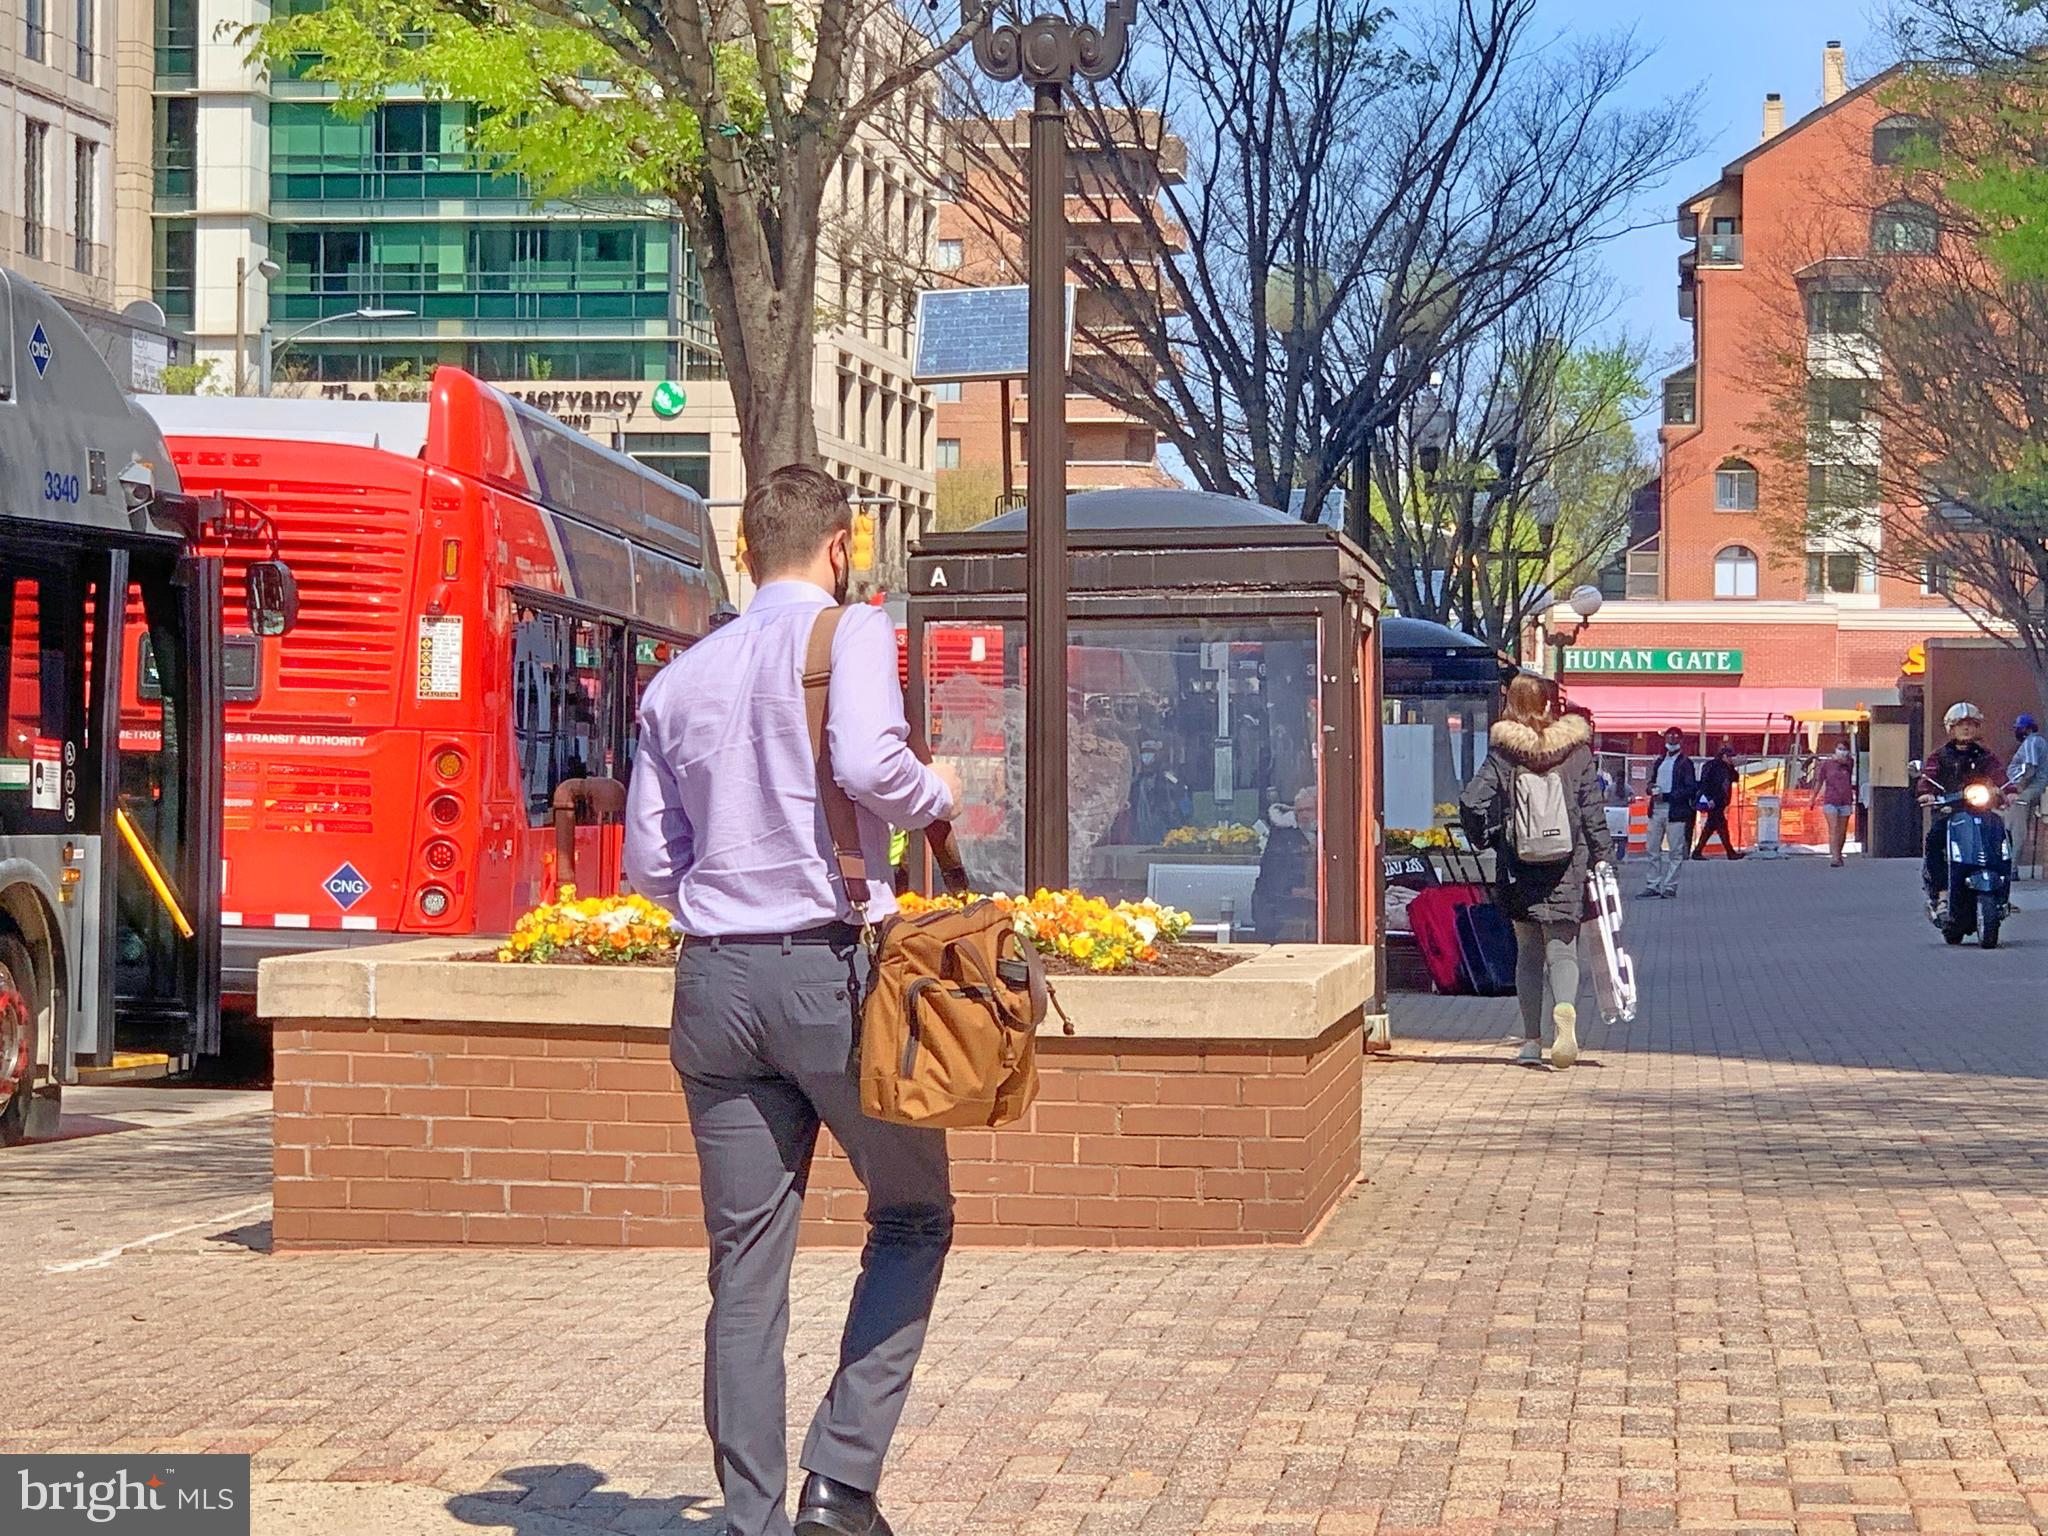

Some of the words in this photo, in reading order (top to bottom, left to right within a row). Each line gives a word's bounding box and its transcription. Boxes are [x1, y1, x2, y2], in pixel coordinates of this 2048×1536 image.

[31, 341, 49, 358] CNG
[523, 390, 643, 424] servancy
[44, 471, 79, 503] 3340
[930, 567, 948, 587] A
[1564, 650, 1653, 670] HUNAN
[1667, 651, 1732, 671] GATE
[246, 732, 296, 744] TRANSIT
[298, 735, 367, 747] AUTHORITY
[330, 879, 364, 894] CNG
